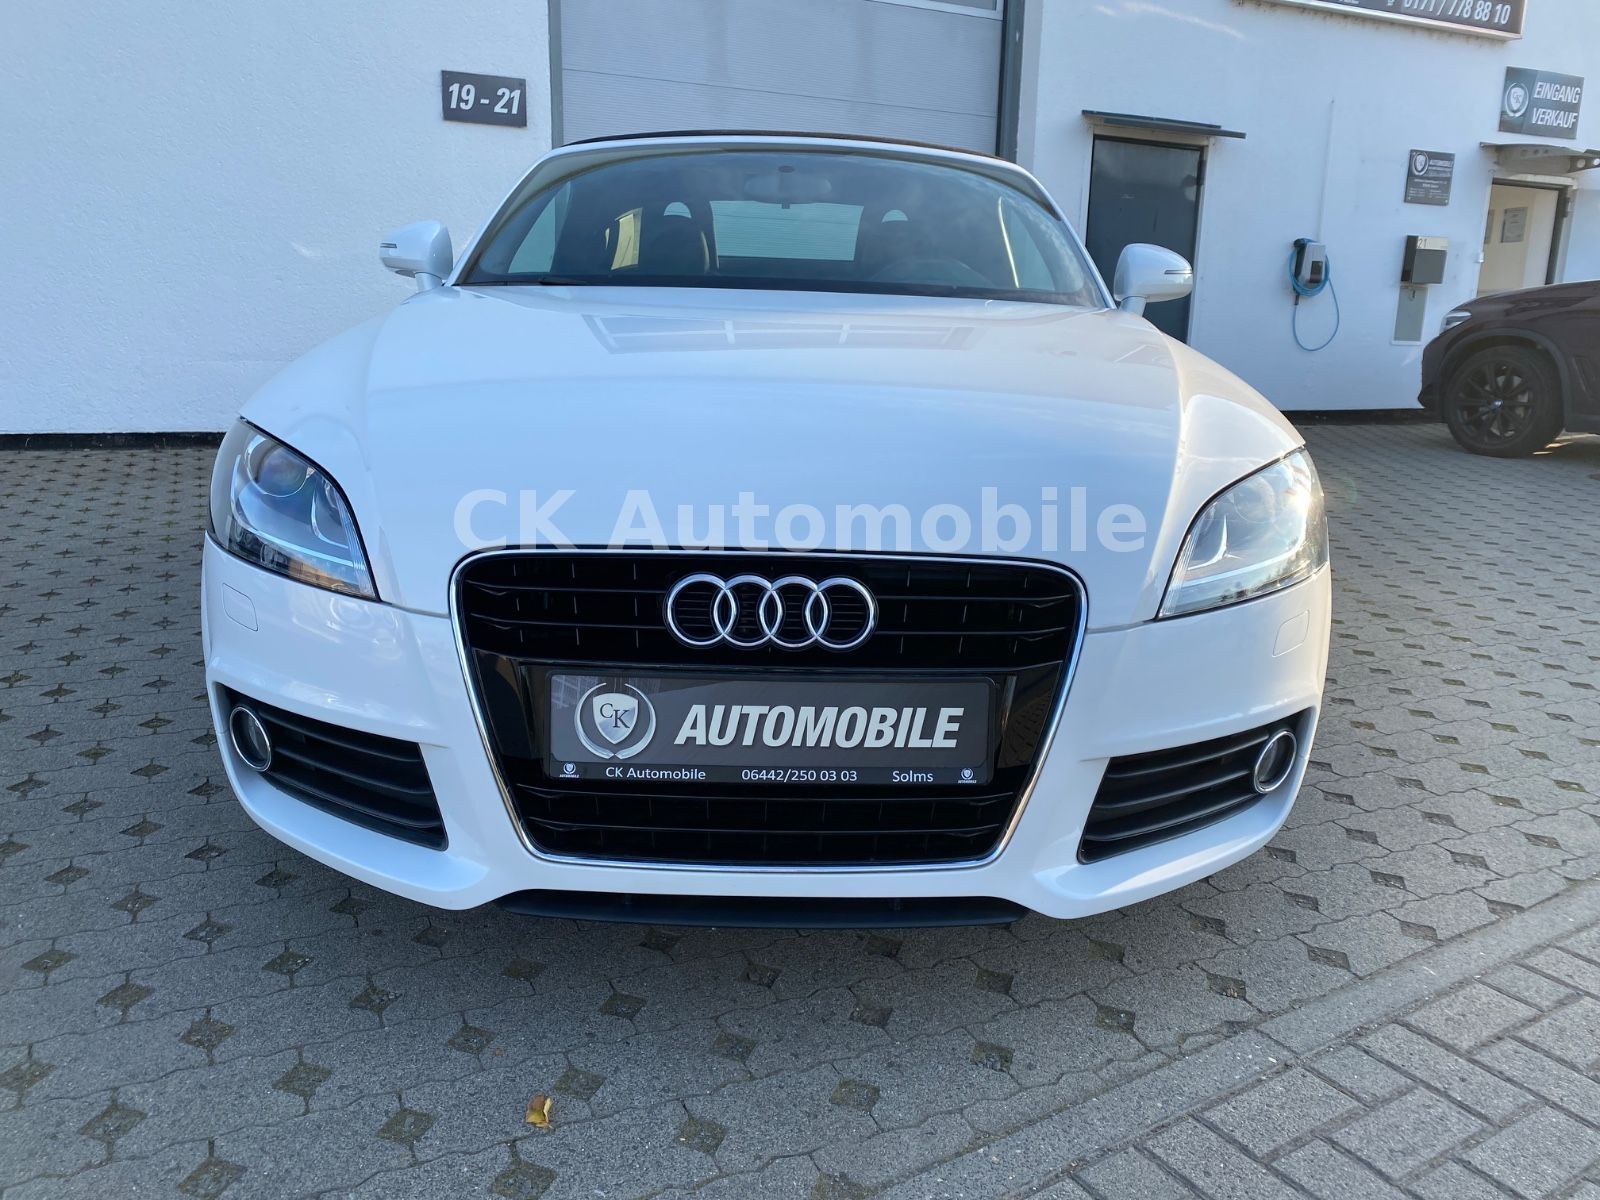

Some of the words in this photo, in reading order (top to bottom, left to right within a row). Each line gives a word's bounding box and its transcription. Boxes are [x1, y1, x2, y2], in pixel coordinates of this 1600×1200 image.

[1474, 0, 1492, 20] 88
[1494, 4, 1511, 24] 10
[448, 83, 476, 110] 19
[493, 87, 521, 115] 21
[1534, 81, 1581, 104] EINGANG
[1531, 107, 1578, 128] VERKAUF
[600, 702, 630, 729] CK
[673, 703, 965, 748] AUTOMOBILE
[605, 766, 624, 778] CK
[626, 767, 706, 780] Automobile
[741, 769, 817, 783] 06442/250
[820, 770, 837, 782] 03
[840, 770, 858, 782] 03
[892, 770, 934, 783] Solms
